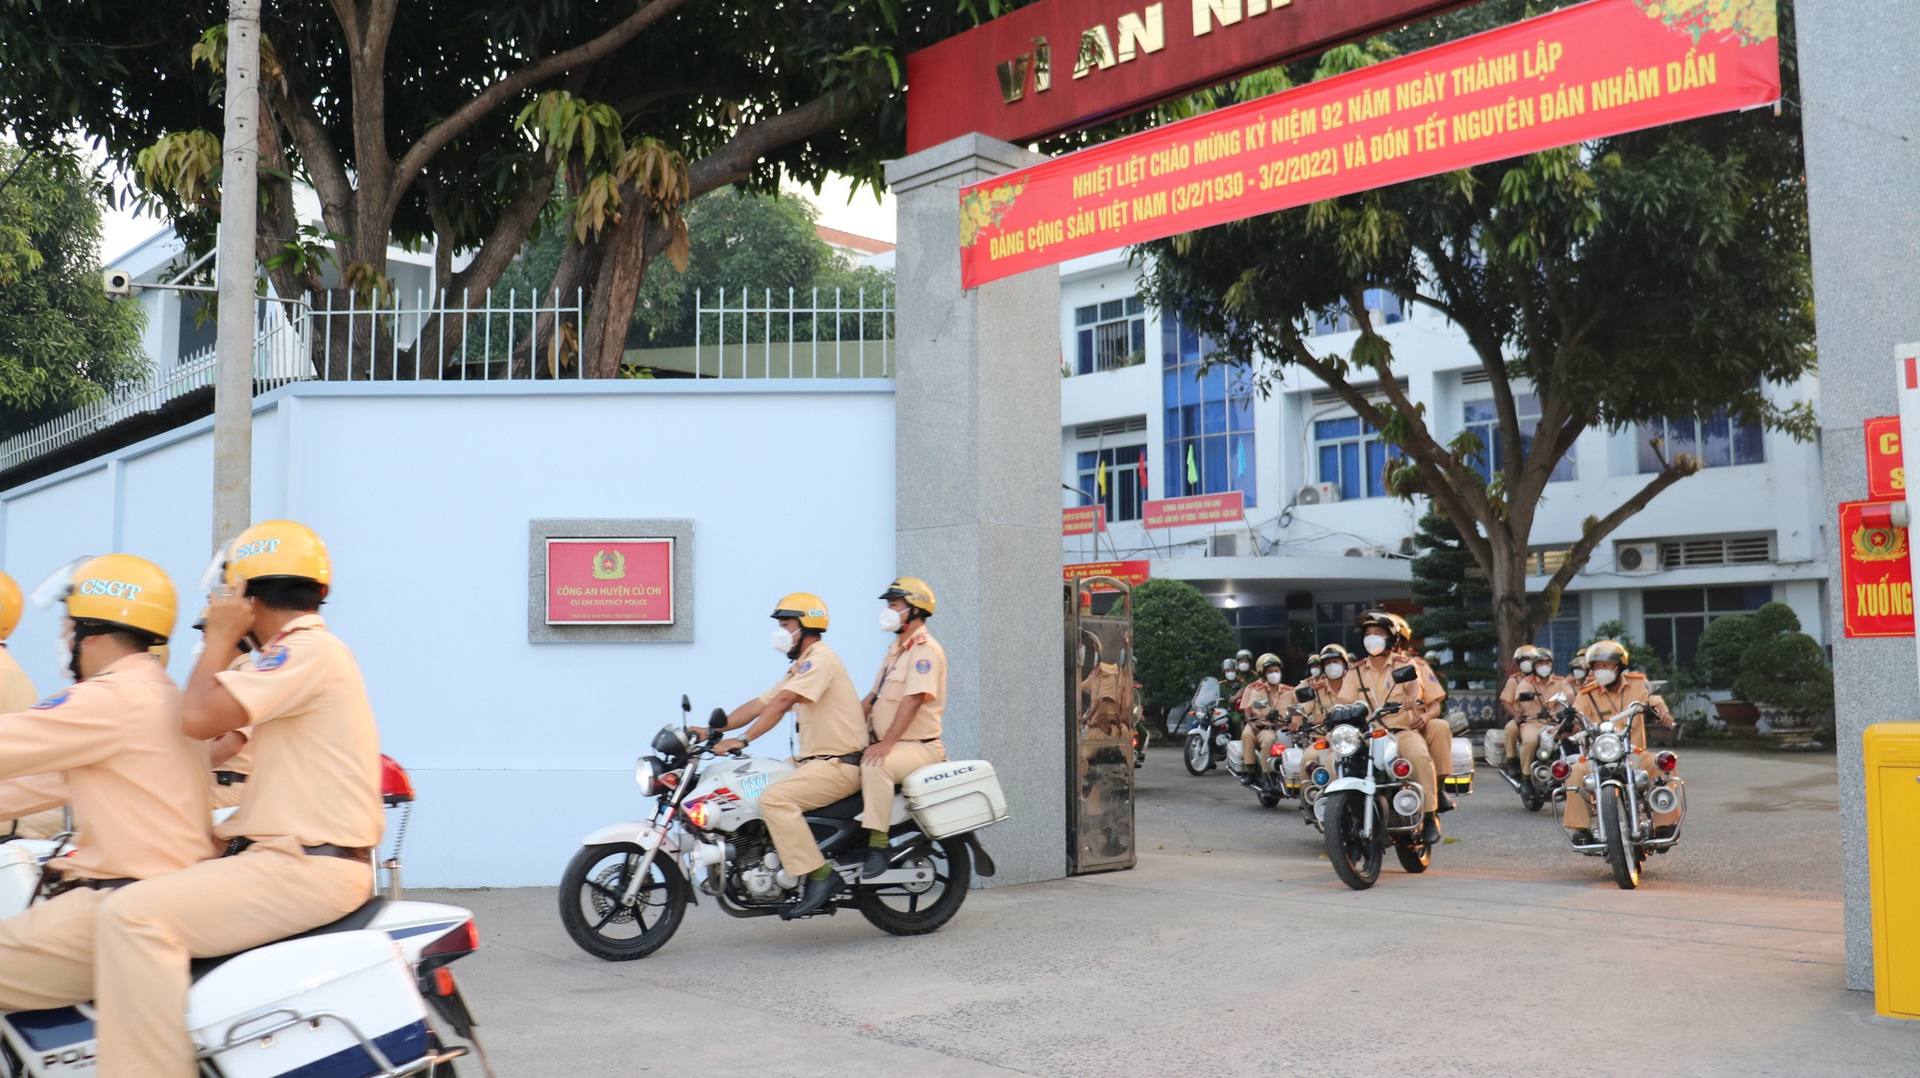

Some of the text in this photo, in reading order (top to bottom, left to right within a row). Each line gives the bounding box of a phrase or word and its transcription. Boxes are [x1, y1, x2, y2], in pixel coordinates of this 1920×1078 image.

[997, 37, 1051, 104] VÌ
[1072, 2, 1164, 80] AN
[1073, 40, 1562, 197] NHIỆT LIỆT CHÀO MỪNG KỶ NIỆM 92 NĂM NGÀY THÀNH LẬP
[990, 229, 1025, 261] ĐẢNG
[1028, 220, 1064, 253] CỘNG
[1067, 207, 1095, 239] SẢN
[1099, 199, 1129, 233] VIỆT
[1133, 191, 1167, 222] NAM
[1172, 171, 1244, 215] (3/2/1930
[1259, 148, 1338, 191] 3/2/2022)
[1343, 136, 1367, 169] VÀ
[1371, 126, 1409, 163] ĐÓN
[1414, 112, 1446, 152] TẾT
[1452, 96, 1534, 144] NGUYÊN
[1540, 83, 1585, 123] ĐÁN
[1592, 67, 1659, 111] NHÂM
[1667, 47, 1716, 94] DẦN
[81, 579, 143, 600] CSGT
[557, 585, 661, 597] CÔNG AN HUYỆN CỦ CHI
[1856, 573, 1913, 616] XUỐNG
[808, 609, 826, 617] CSG
[924, 765, 977, 783] POLICE
[43, 1047, 96, 1070] POL
